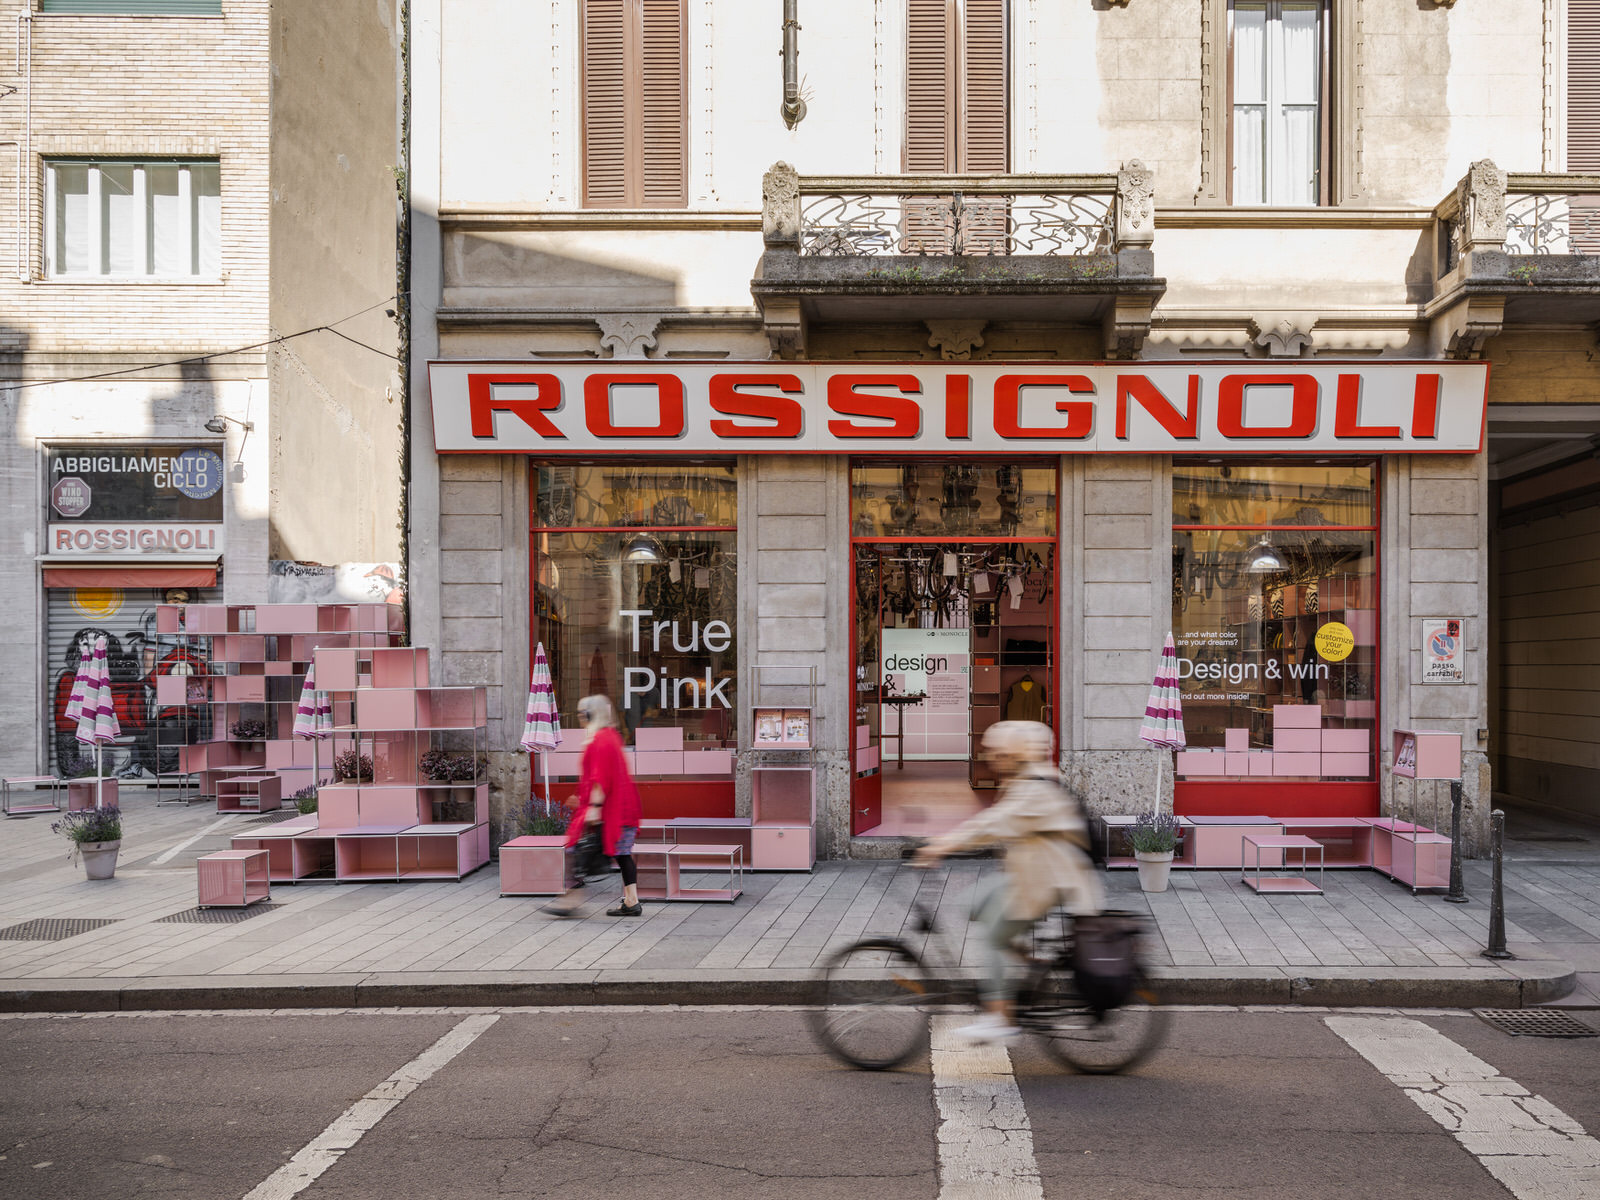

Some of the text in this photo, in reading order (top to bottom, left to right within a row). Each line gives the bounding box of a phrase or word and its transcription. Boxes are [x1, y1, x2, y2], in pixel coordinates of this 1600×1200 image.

[467, 373, 1442, 440] ROSSIGNOLI
[53, 457, 208, 472] ABBIGLIAMENTO
[154, 473, 208, 488] CICLO
[61, 487, 82, 497] WIND
[58, 496, 84, 506] STOPPER
[56, 529, 216, 550] ROSSIGNOLI
[619, 610, 731, 652] True
[1190, 639, 1206, 647] your
[1316, 633, 1354, 645] customize
[1326, 641, 1342, 649] your
[1321, 647, 1343, 656] color!
[884, 653, 947, 675] design
[1177, 658, 1329, 684] Design & win
[624, 667, 732, 709] Pink
[883, 674, 897, 691] &
[1227, 692, 1250, 700] inside!
